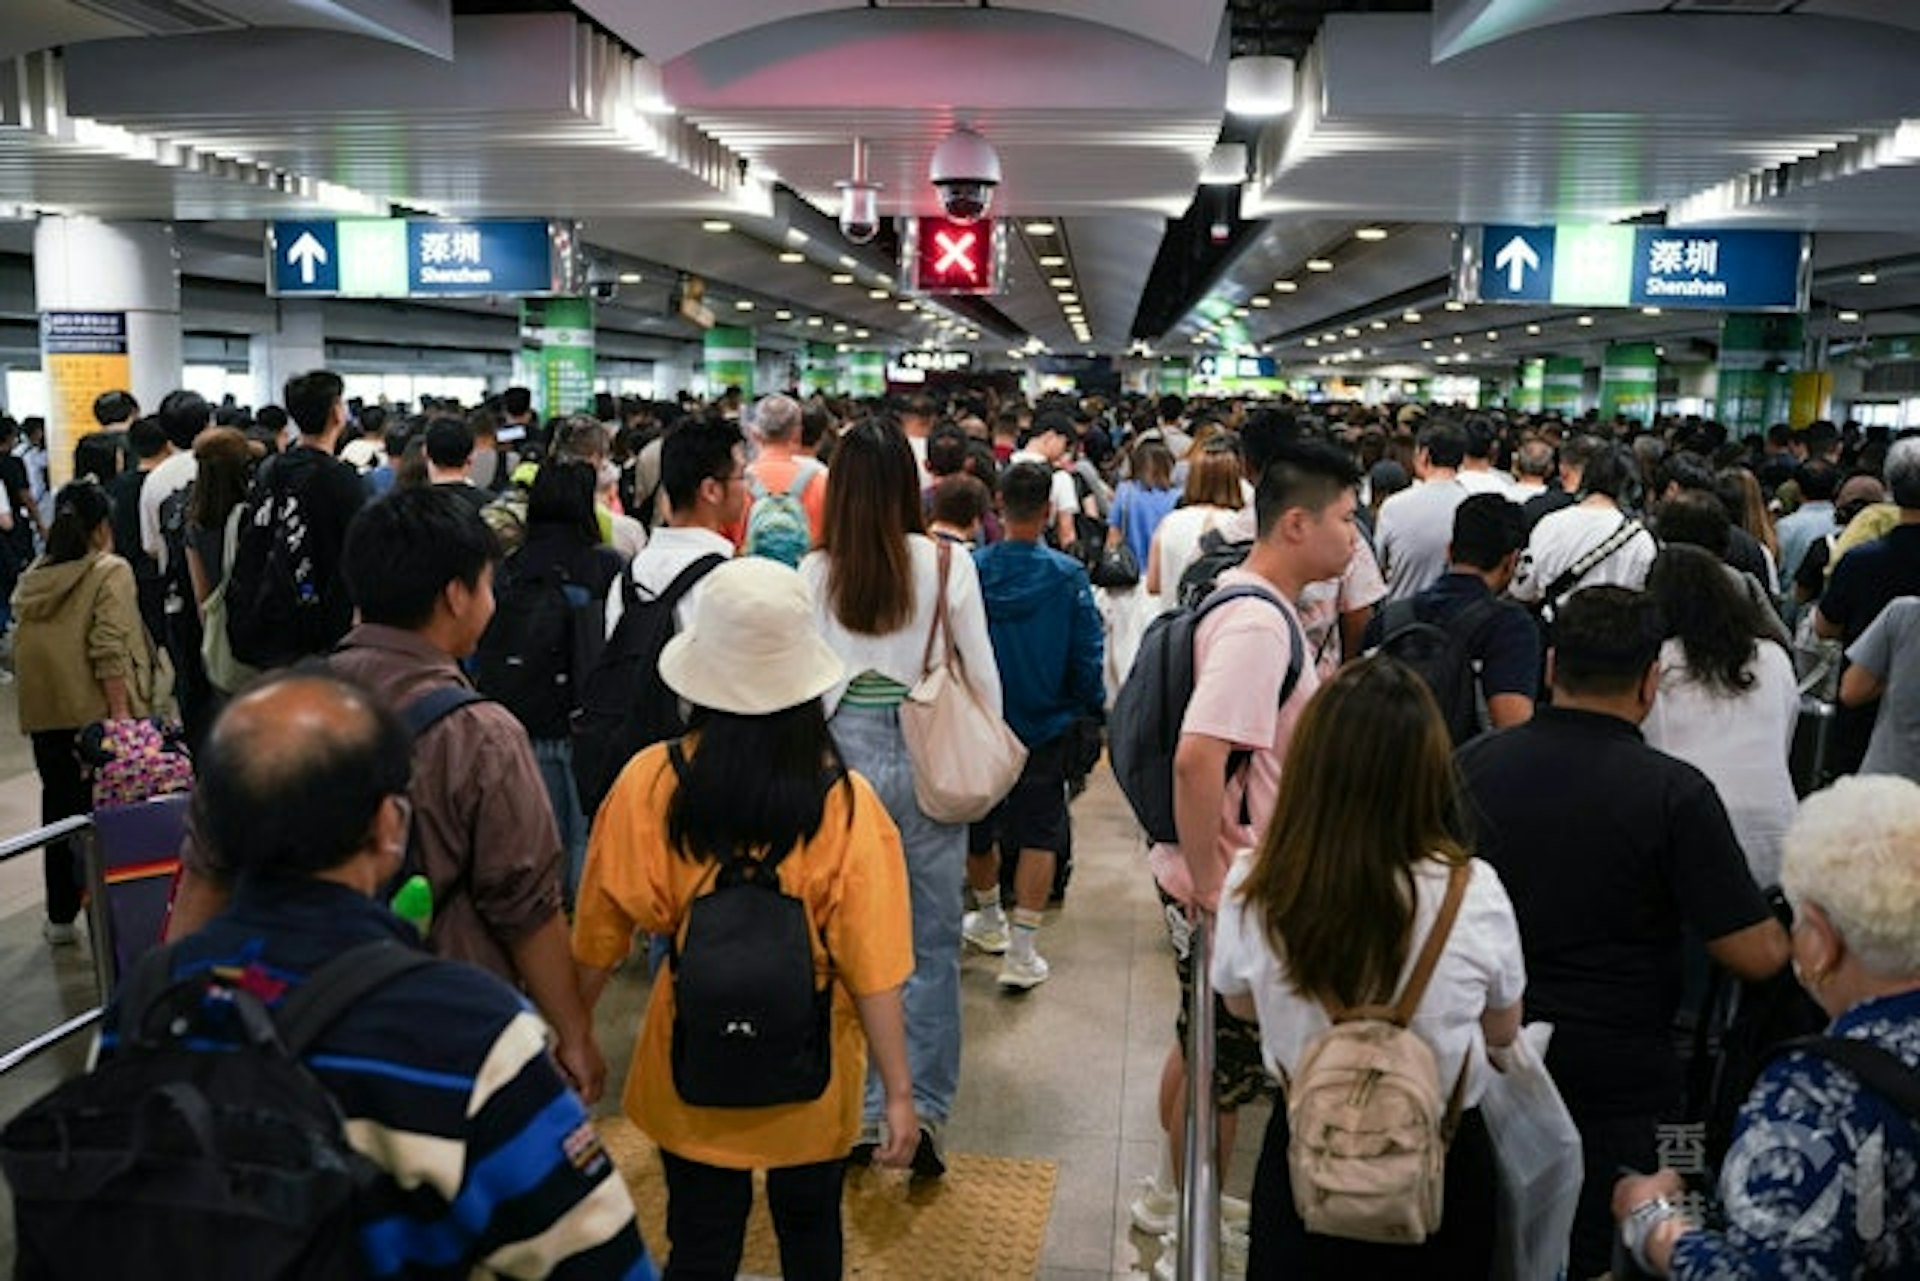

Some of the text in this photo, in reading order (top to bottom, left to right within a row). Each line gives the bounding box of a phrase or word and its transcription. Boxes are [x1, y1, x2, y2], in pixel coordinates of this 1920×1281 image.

[420, 231, 481, 264] 深圳
[1649, 239, 1719, 275] 深圳
[420, 266, 493, 284] Shenzhen
[1645, 278, 1727, 296] Shenzhen
